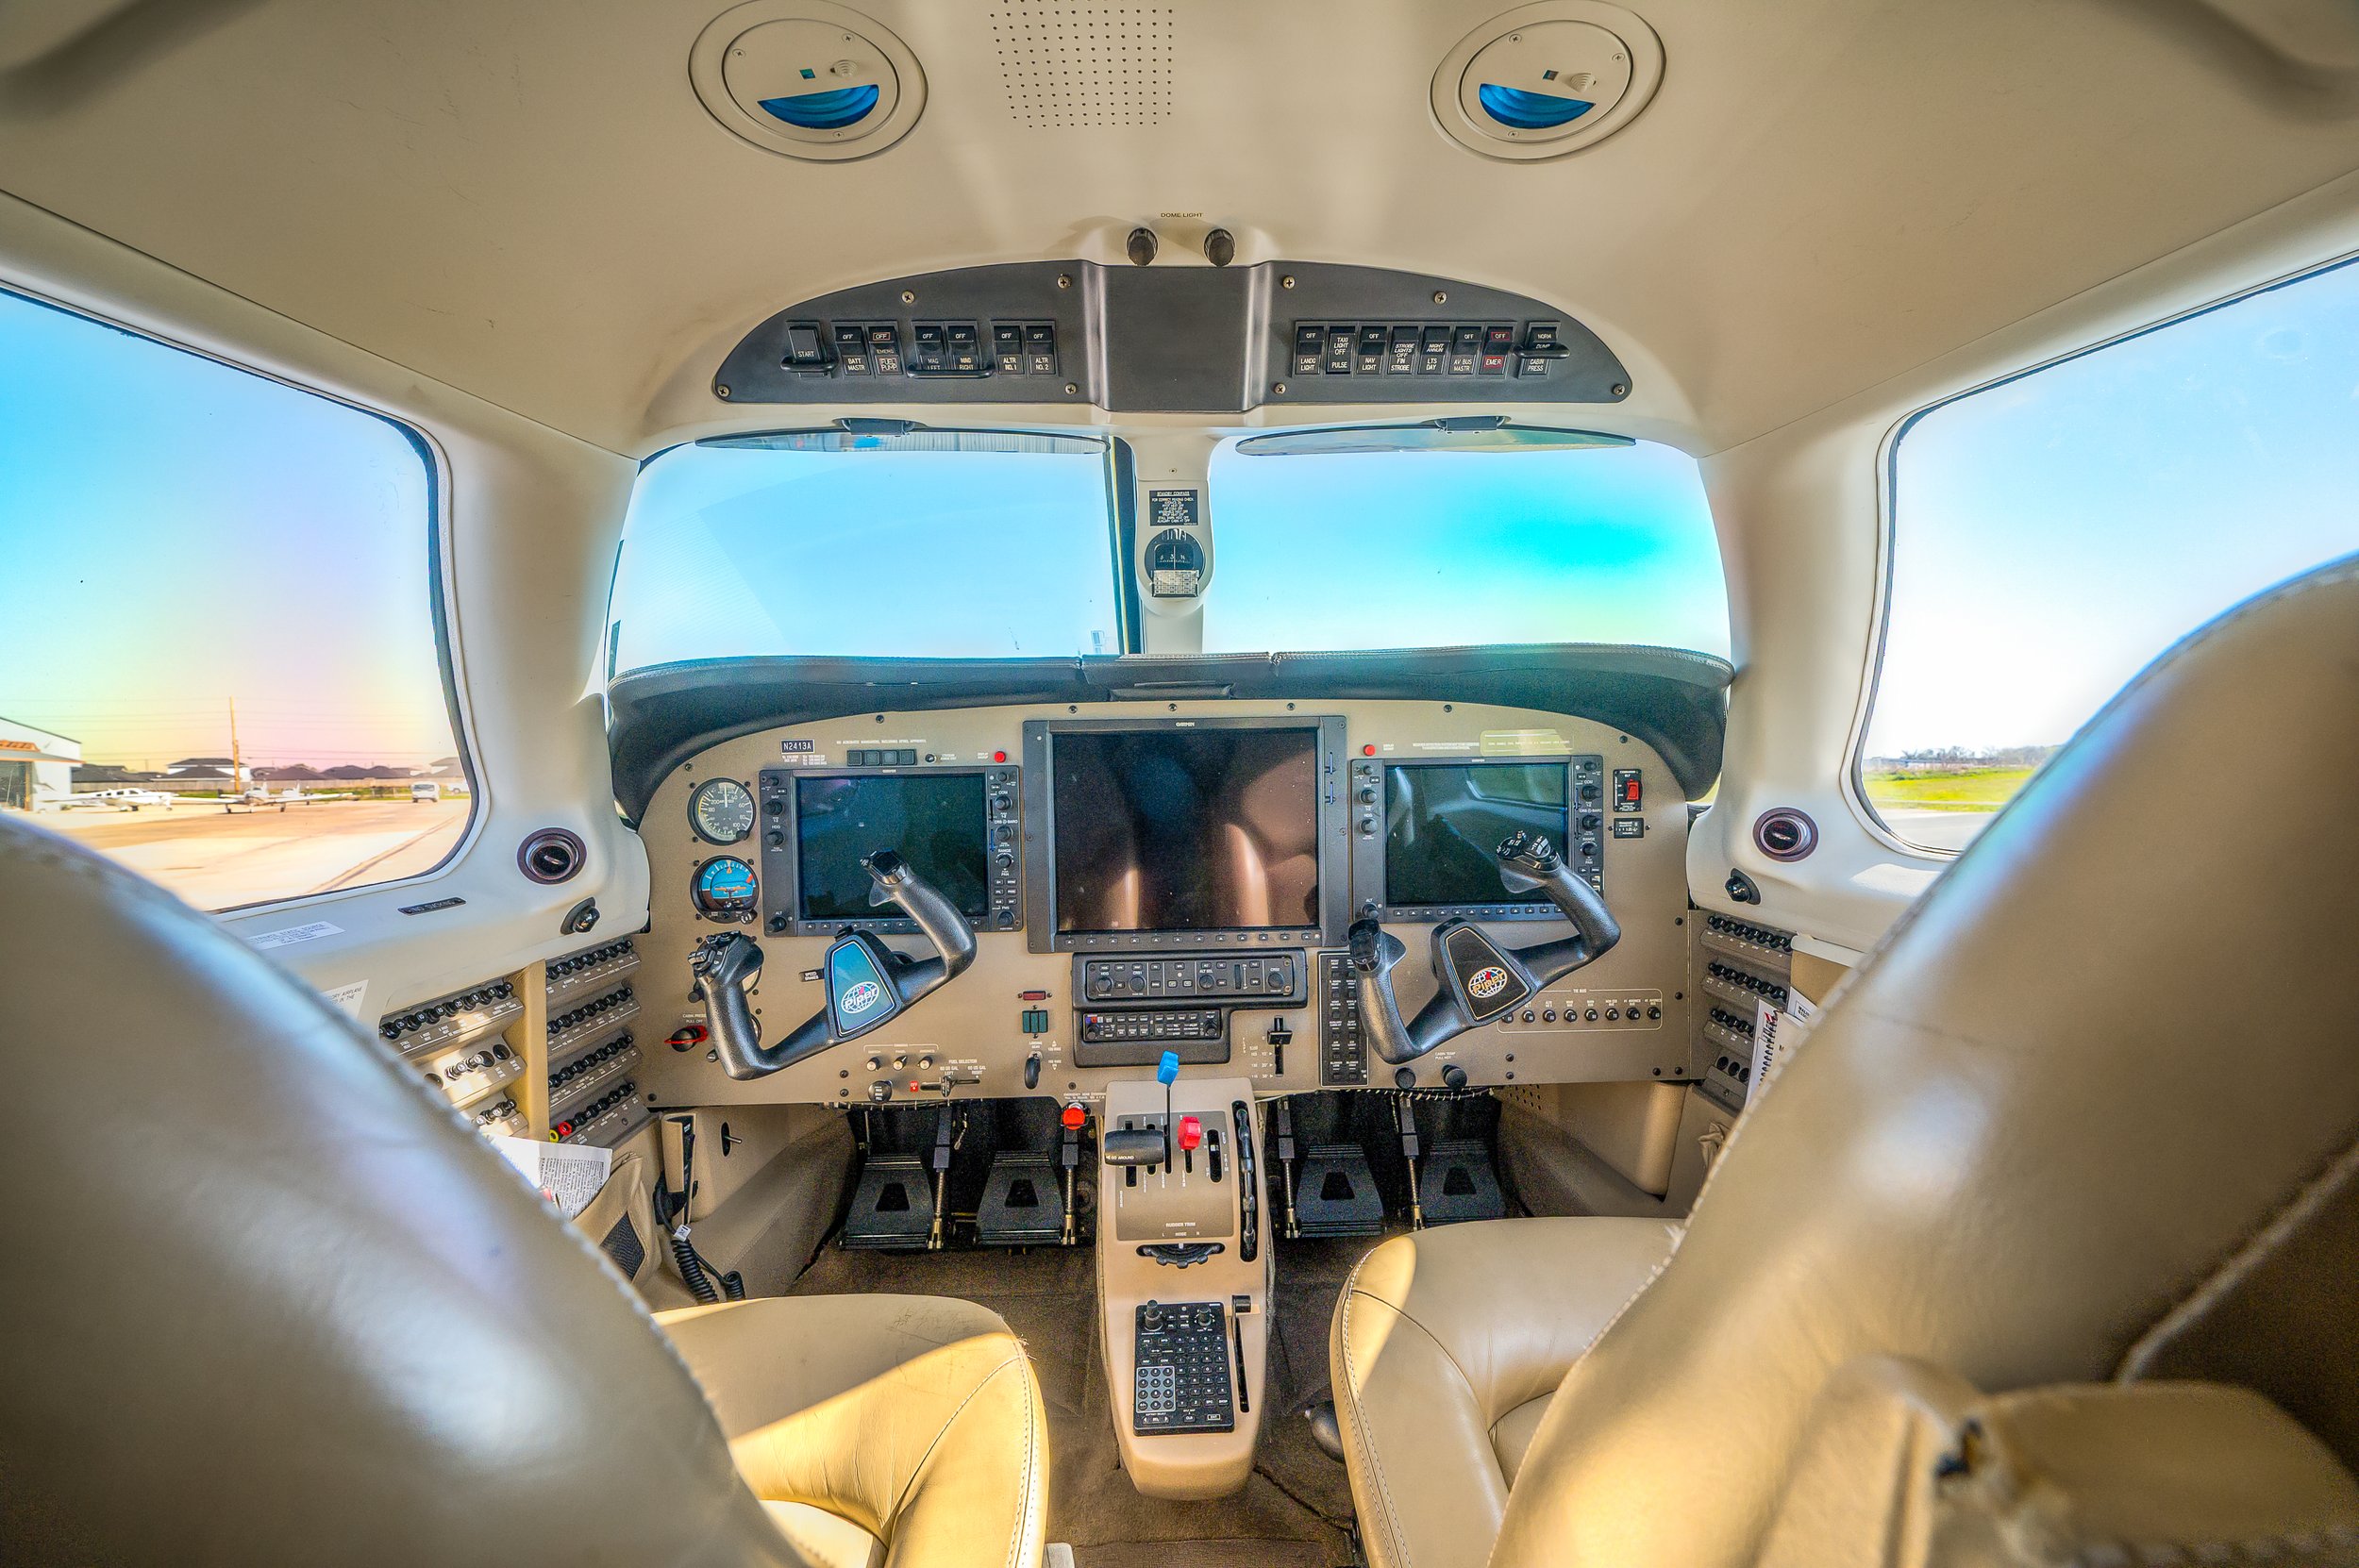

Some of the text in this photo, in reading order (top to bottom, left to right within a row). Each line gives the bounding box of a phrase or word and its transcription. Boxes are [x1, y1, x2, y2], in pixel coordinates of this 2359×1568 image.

[784, 742, 811, 750] N2413A
[1472, 972, 1504, 994] Piper
[844, 987, 878, 1009] Piper
